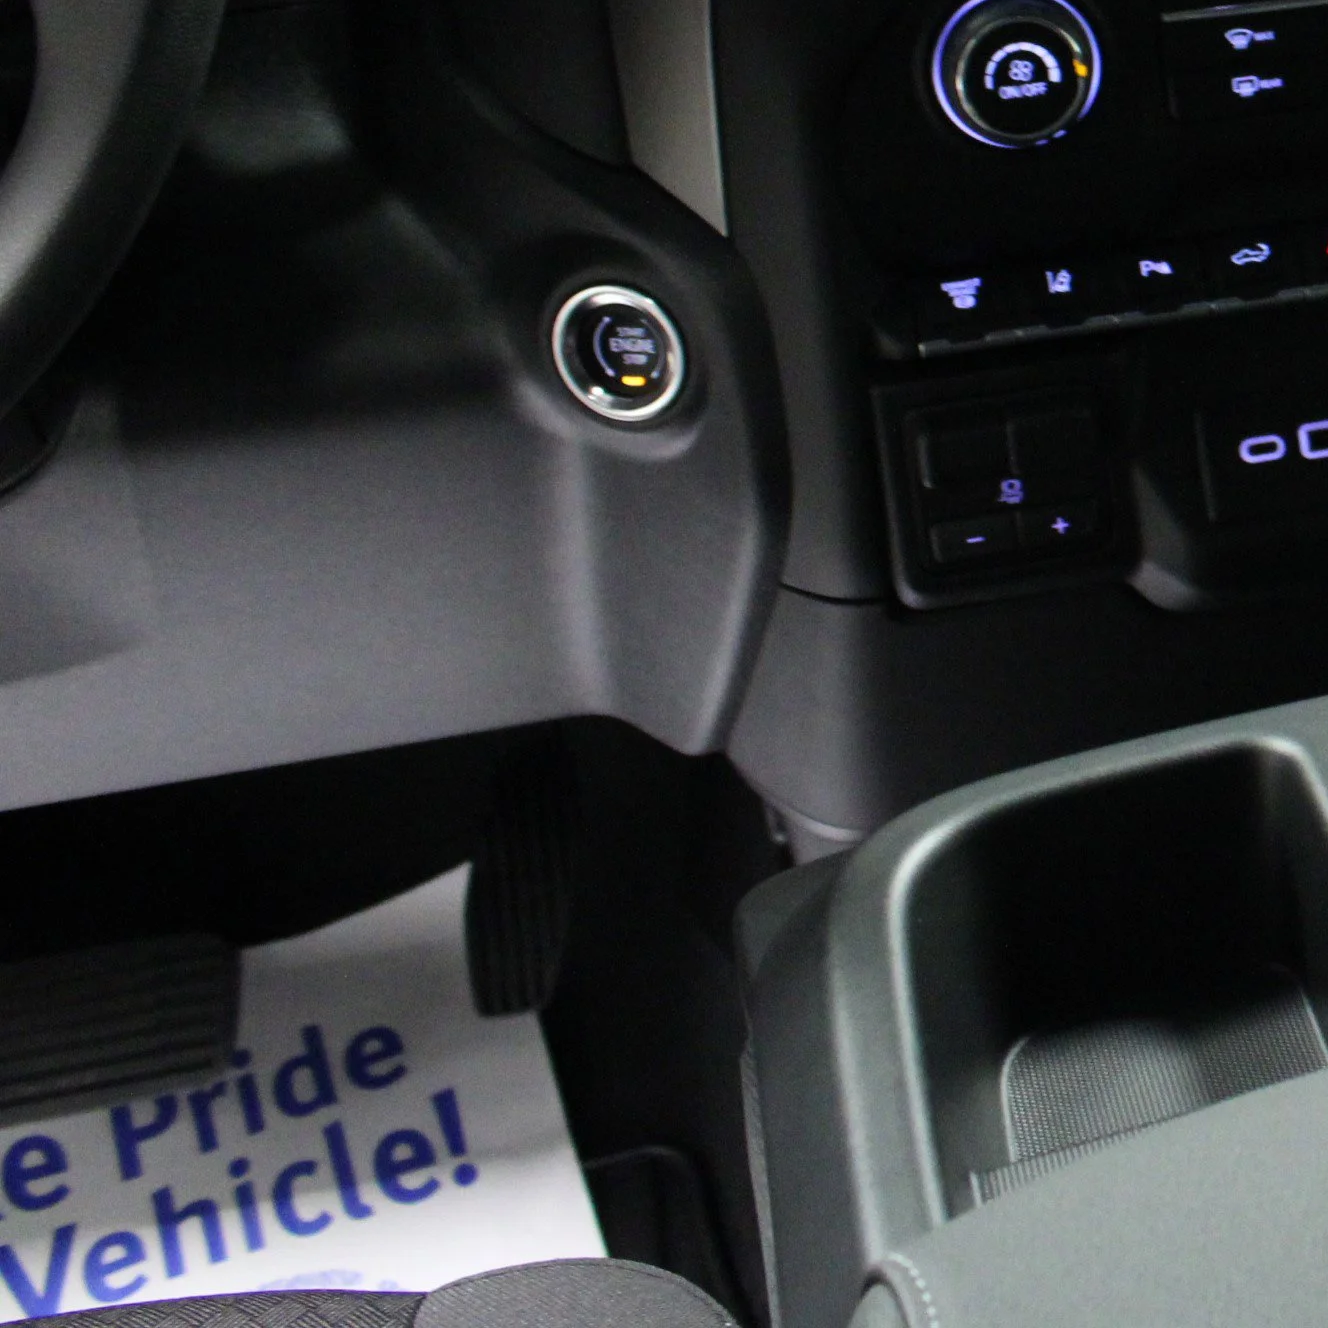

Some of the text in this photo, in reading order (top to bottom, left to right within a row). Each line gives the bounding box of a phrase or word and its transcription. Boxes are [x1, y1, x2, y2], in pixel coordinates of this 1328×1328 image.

[0, 1022, 409, 1220] e Pride
[0, 1087, 480, 1322] Vehicle!
